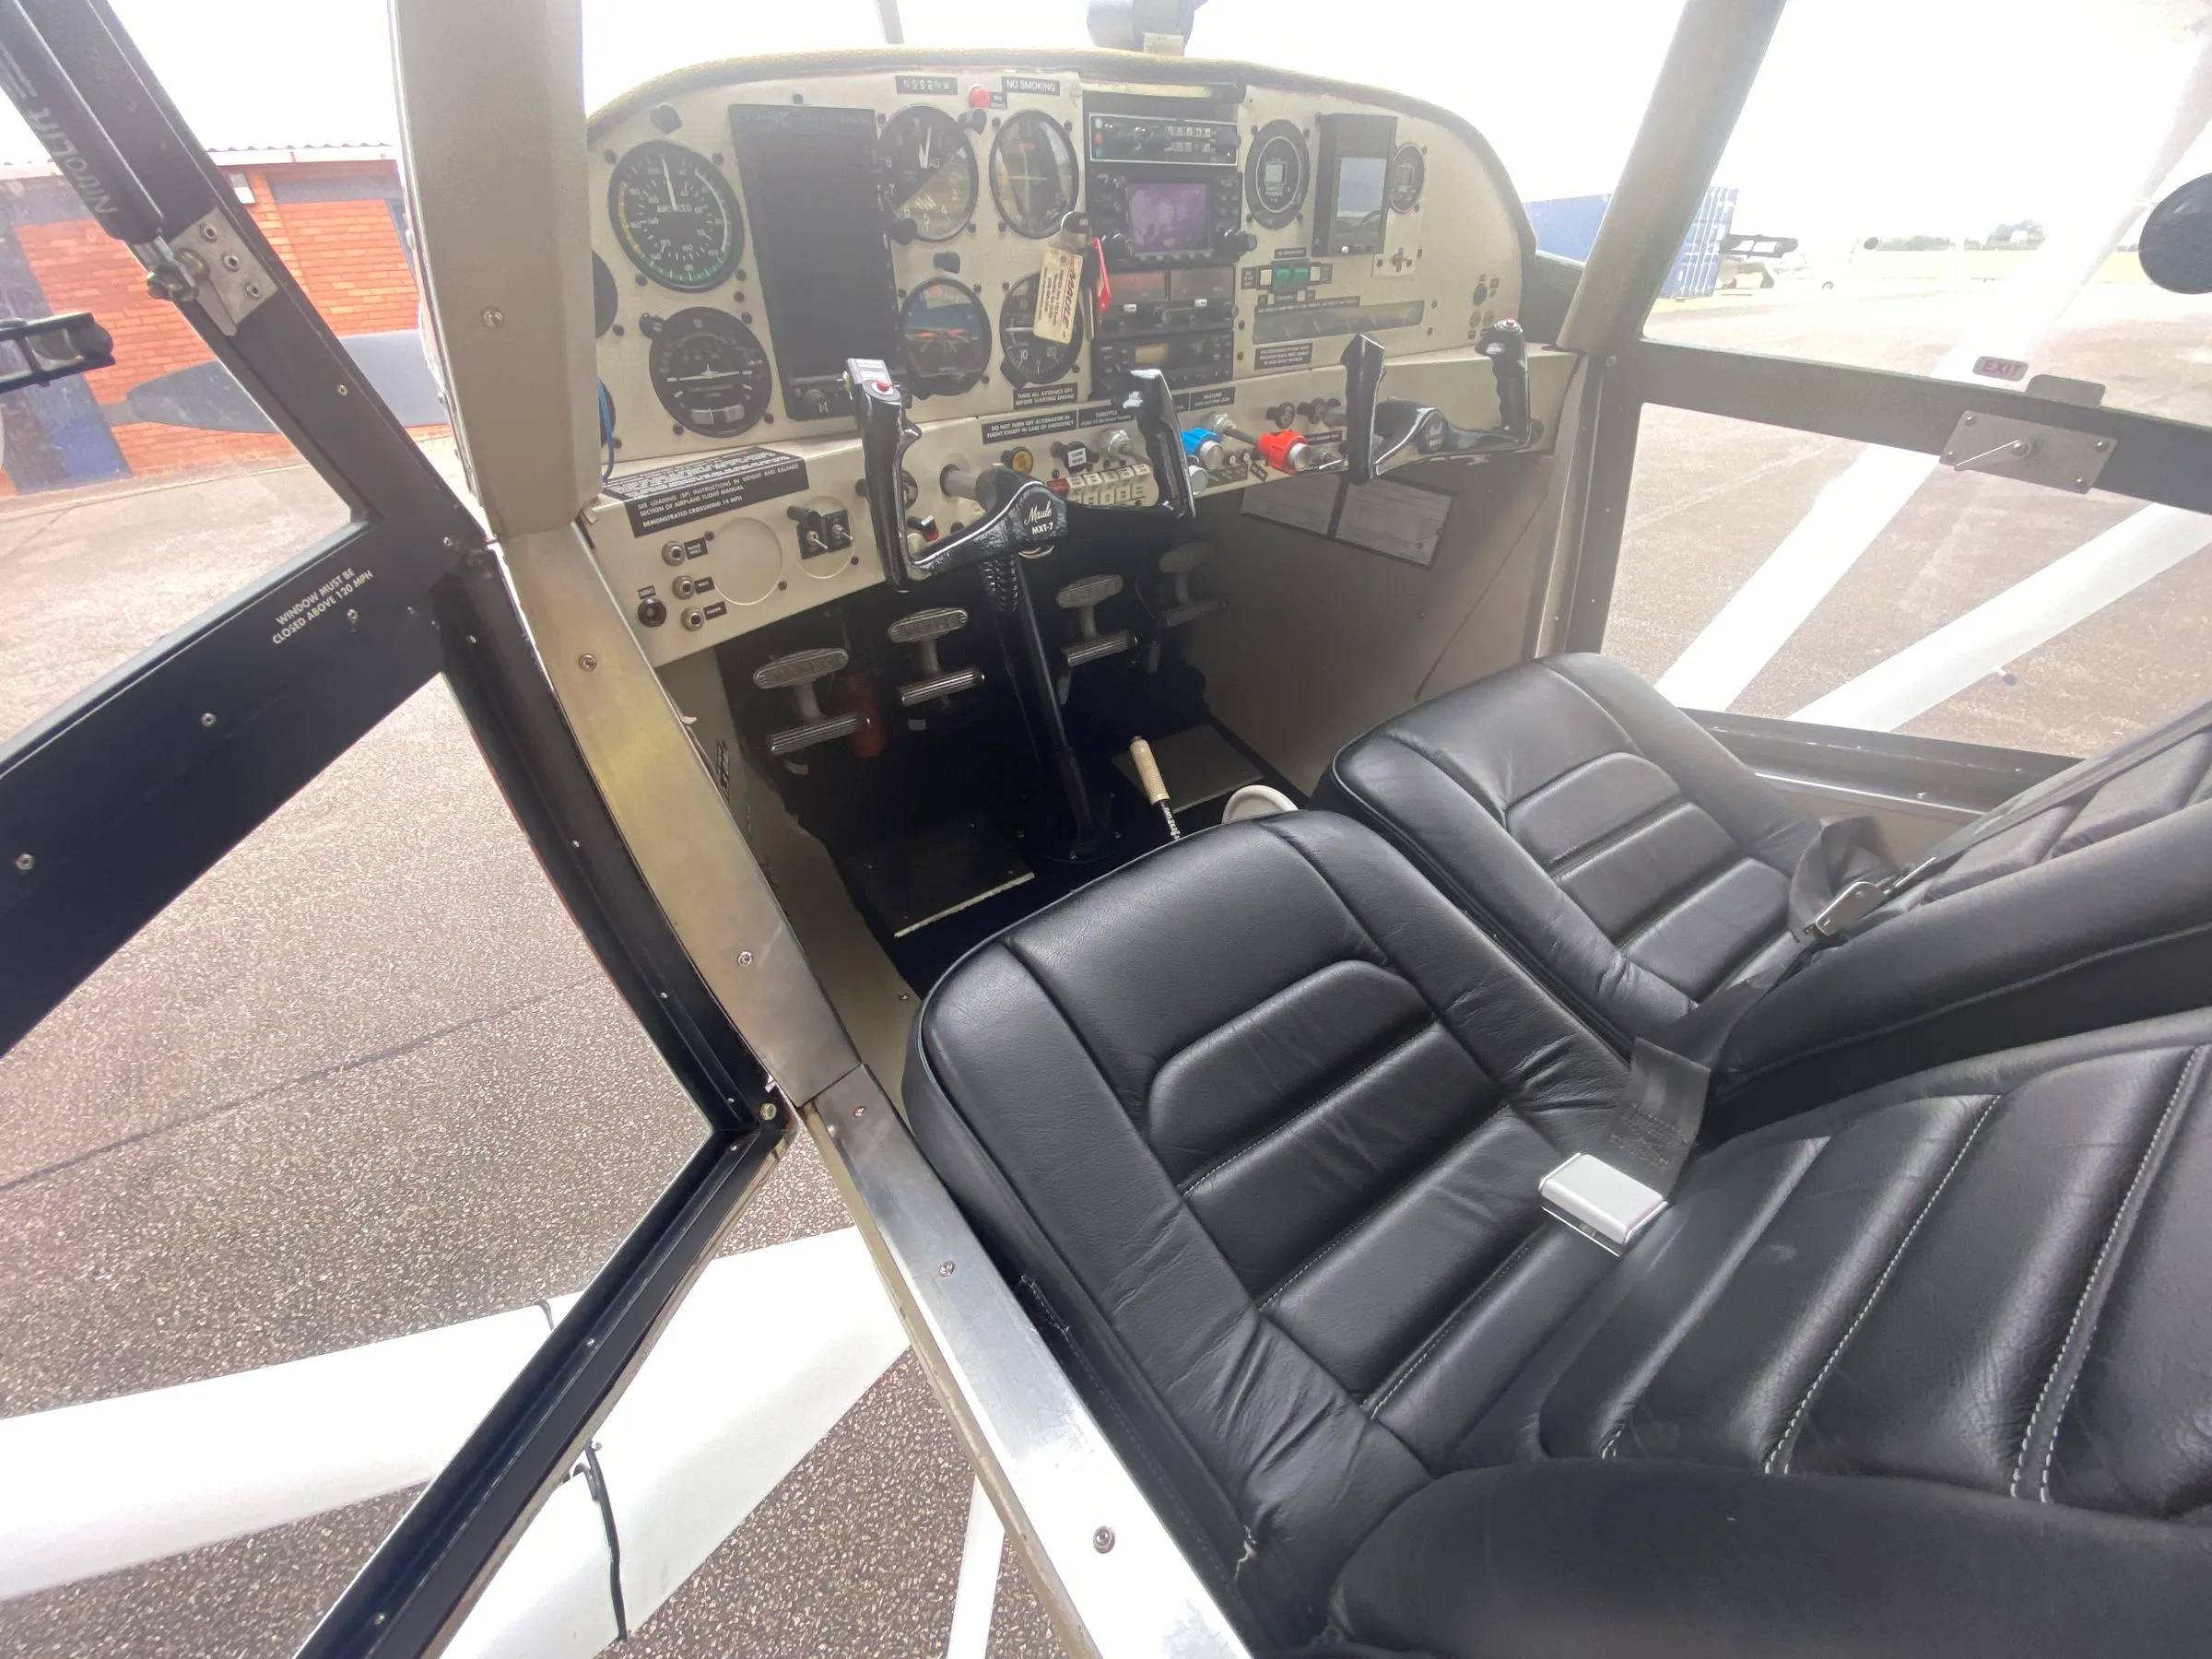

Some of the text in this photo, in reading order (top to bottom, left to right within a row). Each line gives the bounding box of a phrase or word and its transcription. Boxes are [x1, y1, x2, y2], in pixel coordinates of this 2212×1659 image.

[1006, 80, 1056, 92] NO SMOKING
[1064, 271, 1077, 328] MAULE
[1983, 359, 2023, 377] EXIT
[1035, 416, 1064, 424] ALTERNATOR
[1047, 419, 1074, 429] EMERGENCY
[650, 495, 677, 507] LOADING
[693, 480, 731, 495] INSTRUCTIONS
[742, 473, 761, 482] WEIGHT
[777, 464, 799, 473] BALANCE
[640, 506, 665, 517] SECTION
[675, 496, 700, 508] AIRPLANE
[701, 490, 719, 500] FLIGHT
[642, 510, 688, 527] DEMONSTRATED
[688, 500, 722, 514] CROSSWIND
[730, 495, 743, 503] MPH
[1024, 500, 1053, 525] Maule
[1031, 522, 1053, 535] MXT-7
[272, 570, 374, 644] CLOSED ABOVE 120 MPH
[276, 567, 356, 626] WINDOW MUST BE
